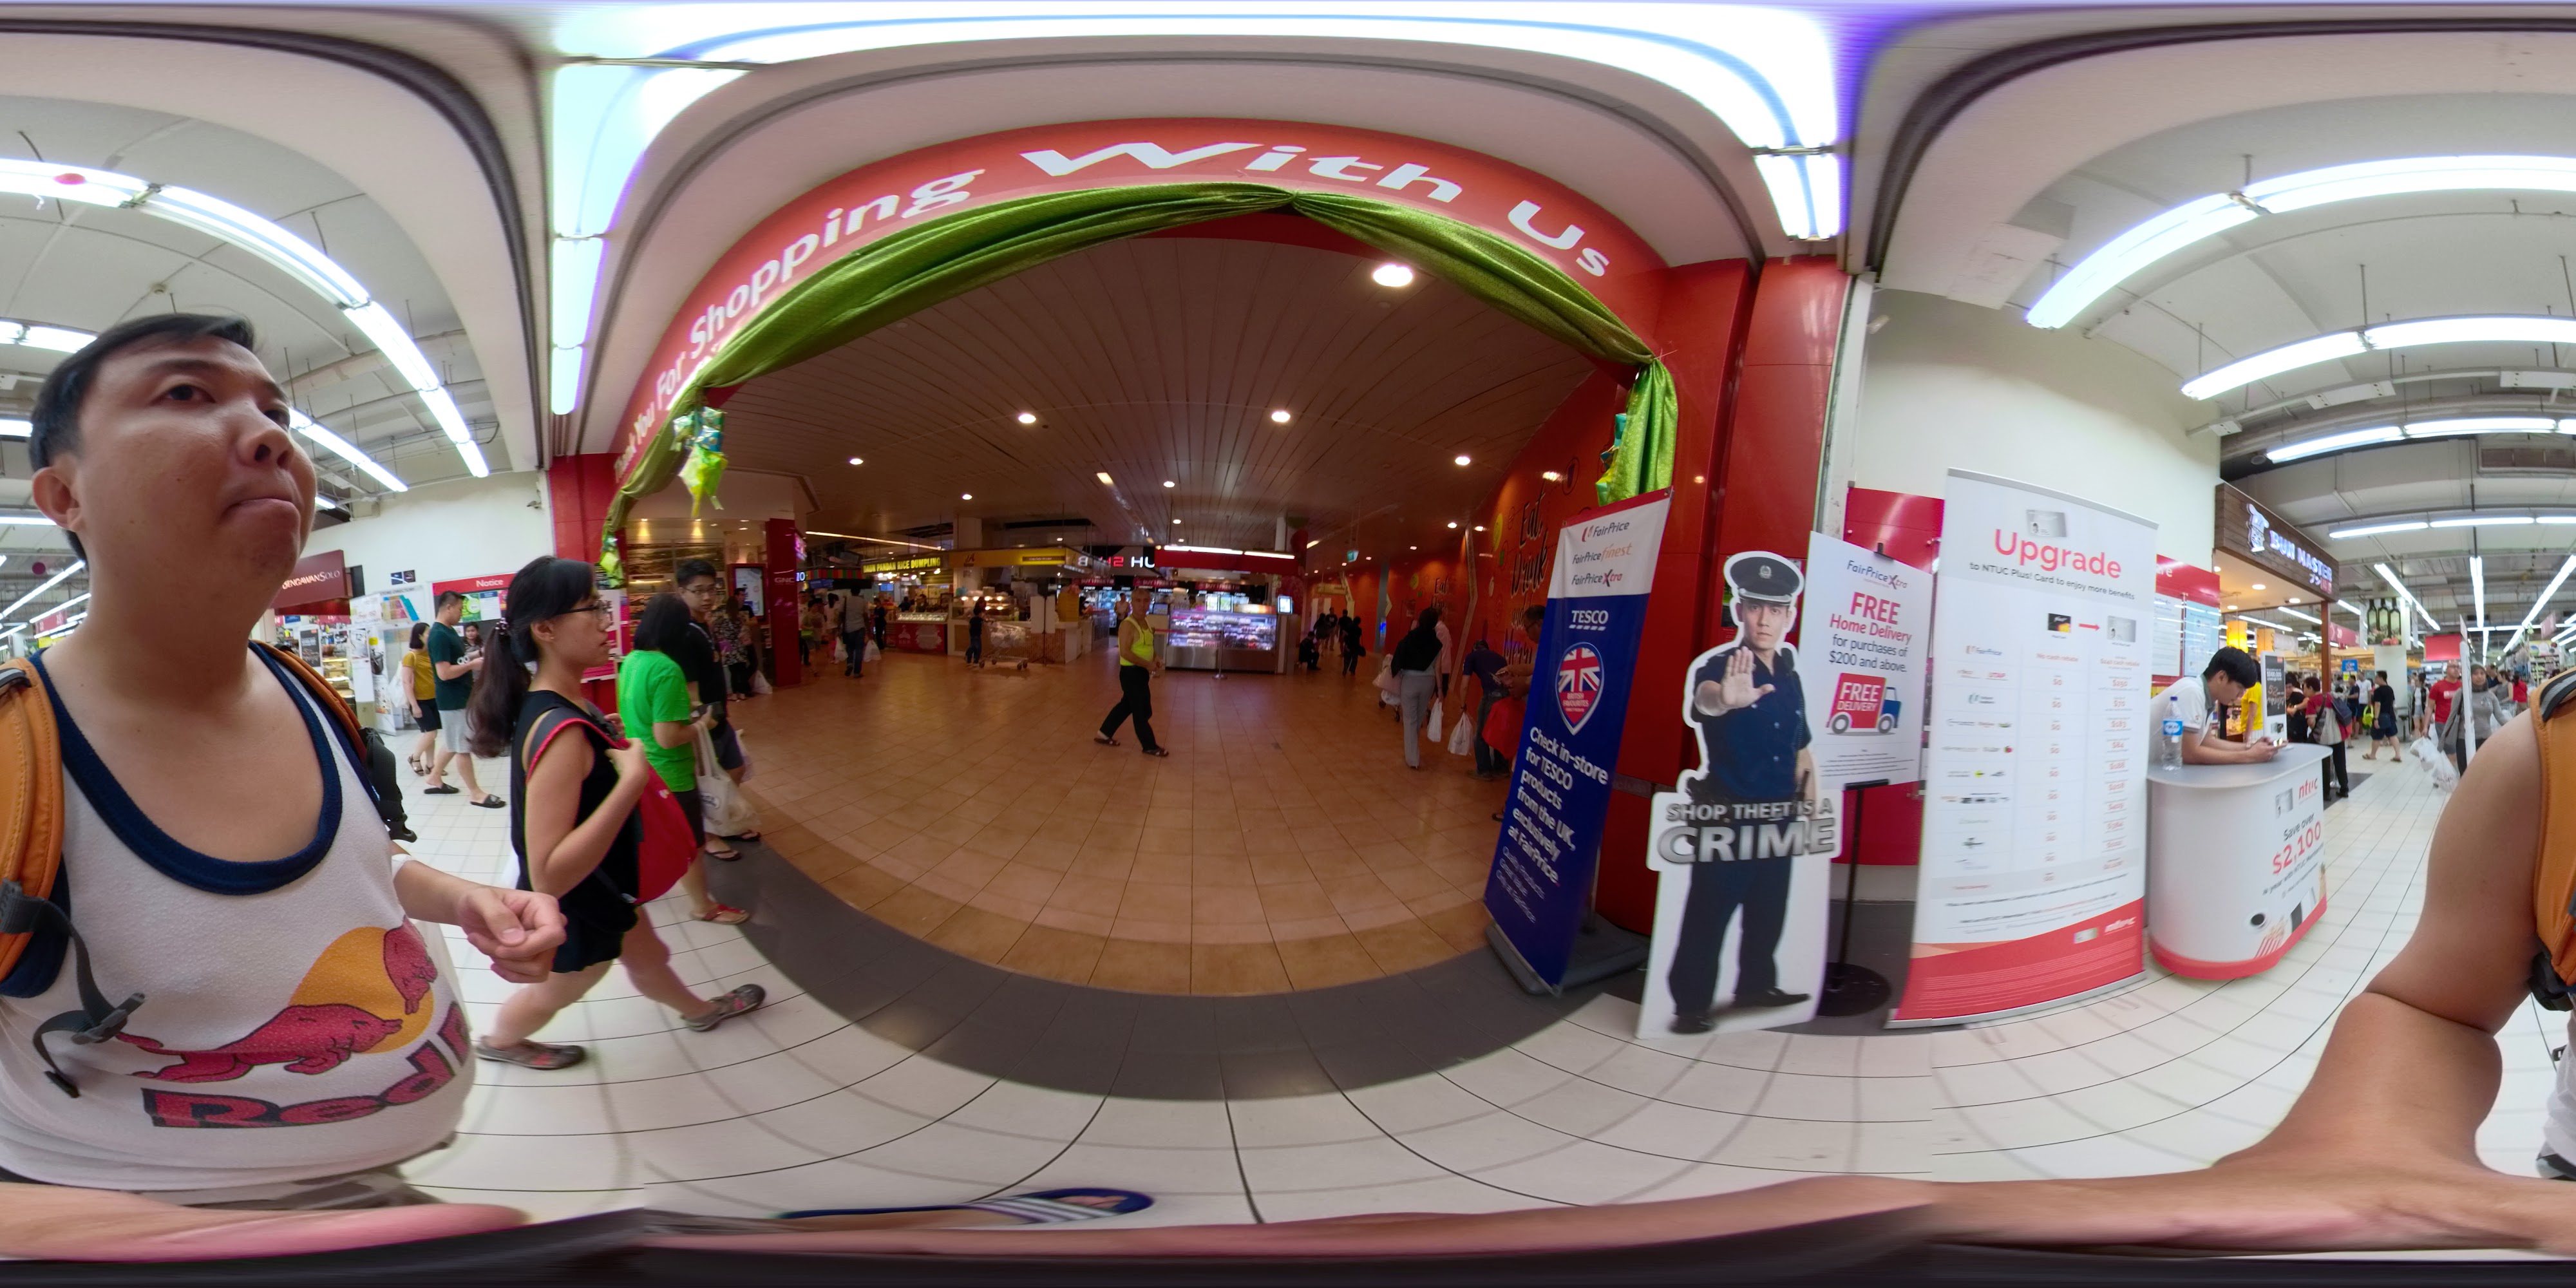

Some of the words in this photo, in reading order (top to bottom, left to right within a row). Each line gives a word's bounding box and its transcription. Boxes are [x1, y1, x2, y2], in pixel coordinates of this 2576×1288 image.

[634, 401, 655, 444] You
[656, 351, 686, 410] For
[690, 169, 985, 358] Shopping
[1019, 142, 1463, 203] With
[1508, 200, 1609, 277] Us
[1593, 522, 1630, 537] FairPrice
[876, 562, 896, 572] PANDAN
[897, 560, 910, 570] RICE
[911, 557, 941, 569] DUMPLING
[1572, 551, 1602, 565] FairPrice
[1994, 528, 2121, 579] Upgrade
[2269, 530, 2295, 560] BUN
[2297, 547, 2333, 582] MASTER
[476, 579, 504, 587] Notice
[1571, 573, 1603, 585] FairPrice
[1602, 569, 1623, 587] Xtra
[1846, 560, 1888, 582] FairPrice
[1888, 574, 1908, 590] Xtra
[1969, 562, 1980, 570] to
[1982, 564, 2009, 575] NTUC
[2011, 569, 2032, 580] Plus!
[2034, 573, 2054, 584] Card
[2056, 577, 2064, 585] to
[2066, 580, 2087, 592] enjoy
[2087, 585, 2107, 594] more
[2108, 587, 2136, 600] benefits
[1571, 609, 1609, 625] TESCO
[1850, 591, 1901, 625] FREE
[1829, 613, 1867, 634] Home
[1869, 621, 1912, 645] Delivery
[1829, 649, 1857, 667] $200
[1859, 657, 1878, 668] and
[1879, 659, 1908, 672] above.
[1832, 634, 1848, 647] for
[1850, 640, 1897, 656] purchases
[1898, 647, 1908, 658] of
[1836, 700, 1879, 712] DELIVERY
[1839, 681, 1882, 702] FREE
[1526, 746, 1541, 766] for
[1540, 755, 1573, 791] TESCO
[1530, 726, 1559, 757] Check
[1558, 742, 1609, 785] in-store
[1520, 769, 1563, 810] products
[2298, 777, 2318, 799] ntuc
[1517, 786, 1539, 815] from
[1537, 805, 1556, 830] the
[1556, 819, 1577, 852] UK,
[1665, 802, 1728, 822] SHOP
[1732, 801, 1792, 820] THEFT
[1796, 799, 1814, 816] IS
[1819, 798, 1833, 814] A
[1508, 826, 1520, 842] at
[1512, 808, 1562, 862] exclusively
[1656, 817, 1835, 864] CRIME
[2284, 823, 2300, 841] Save
[2301, 813, 2315, 829] over
[2273, 820, 2321, 875] $2,100
[140, 1039, 456, 1129] Red
